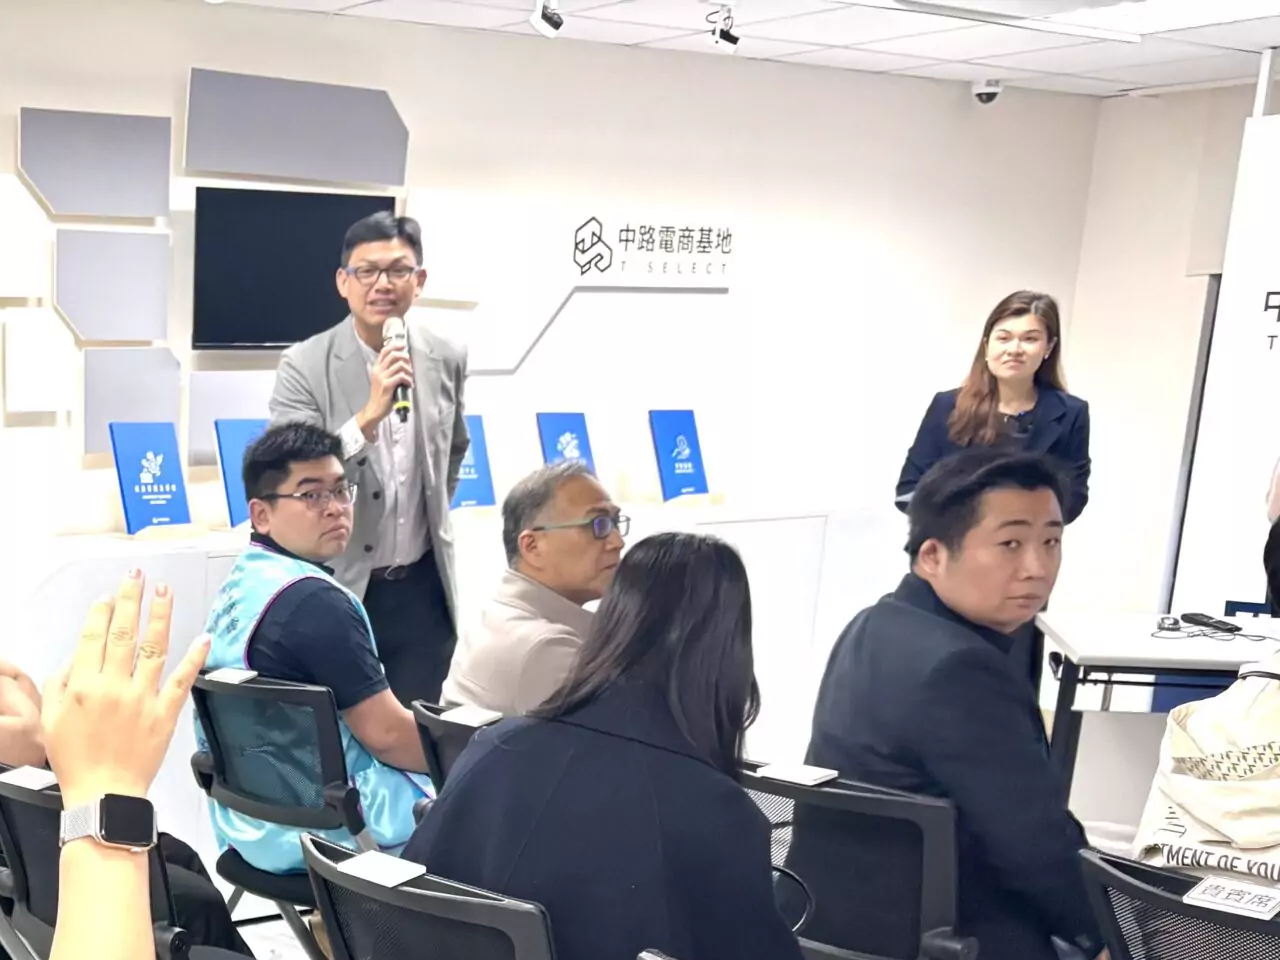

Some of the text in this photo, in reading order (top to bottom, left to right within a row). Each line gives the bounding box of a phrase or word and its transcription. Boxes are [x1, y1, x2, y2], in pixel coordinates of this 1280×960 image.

[619, 223, 732, 255] 中路電商基地
[647, 261, 728, 275] SELECT
